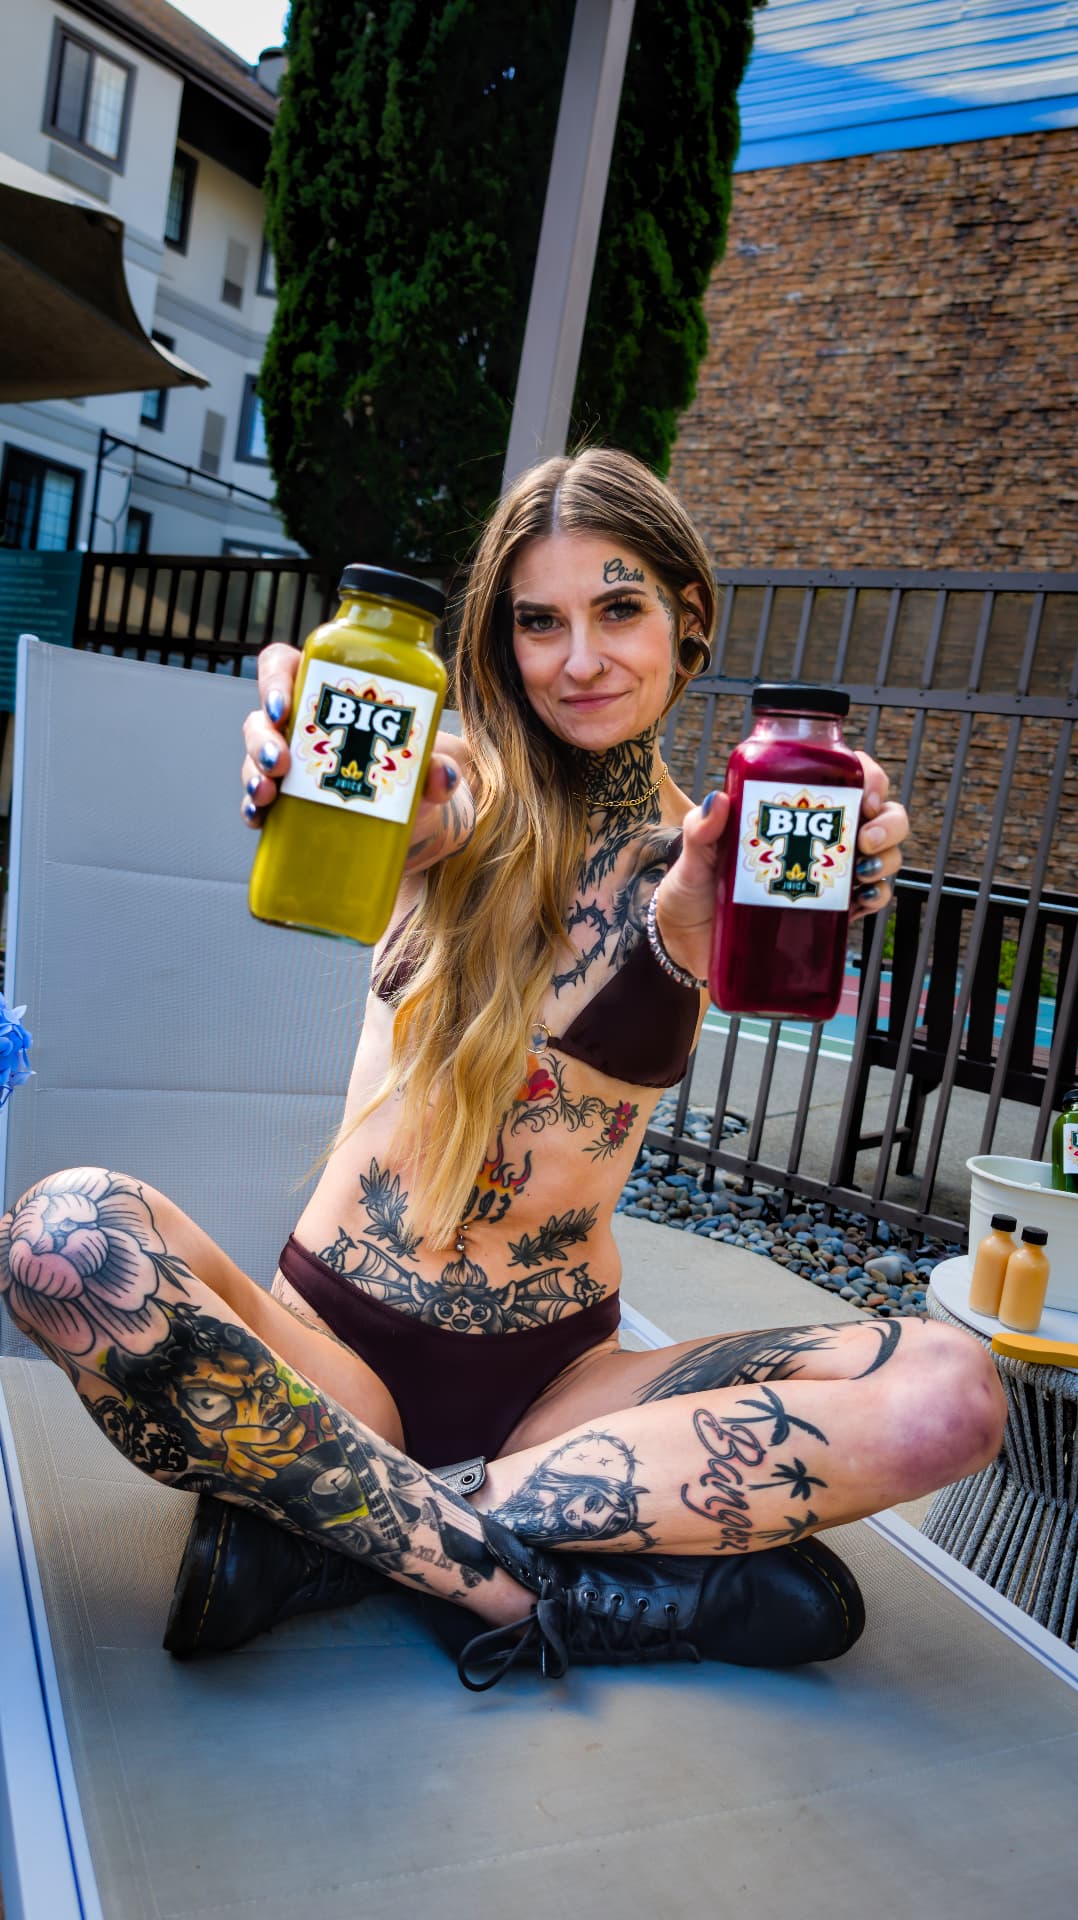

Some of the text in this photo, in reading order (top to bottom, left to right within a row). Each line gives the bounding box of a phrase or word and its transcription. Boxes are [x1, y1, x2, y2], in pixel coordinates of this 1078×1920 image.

[326, 694, 401, 742] BIG
[335, 779, 362, 792] JUICE
[766, 808, 834, 841] BIG
[782, 880, 807, 891] JUICE
[681, 1408, 767, 1551] Bangerz
